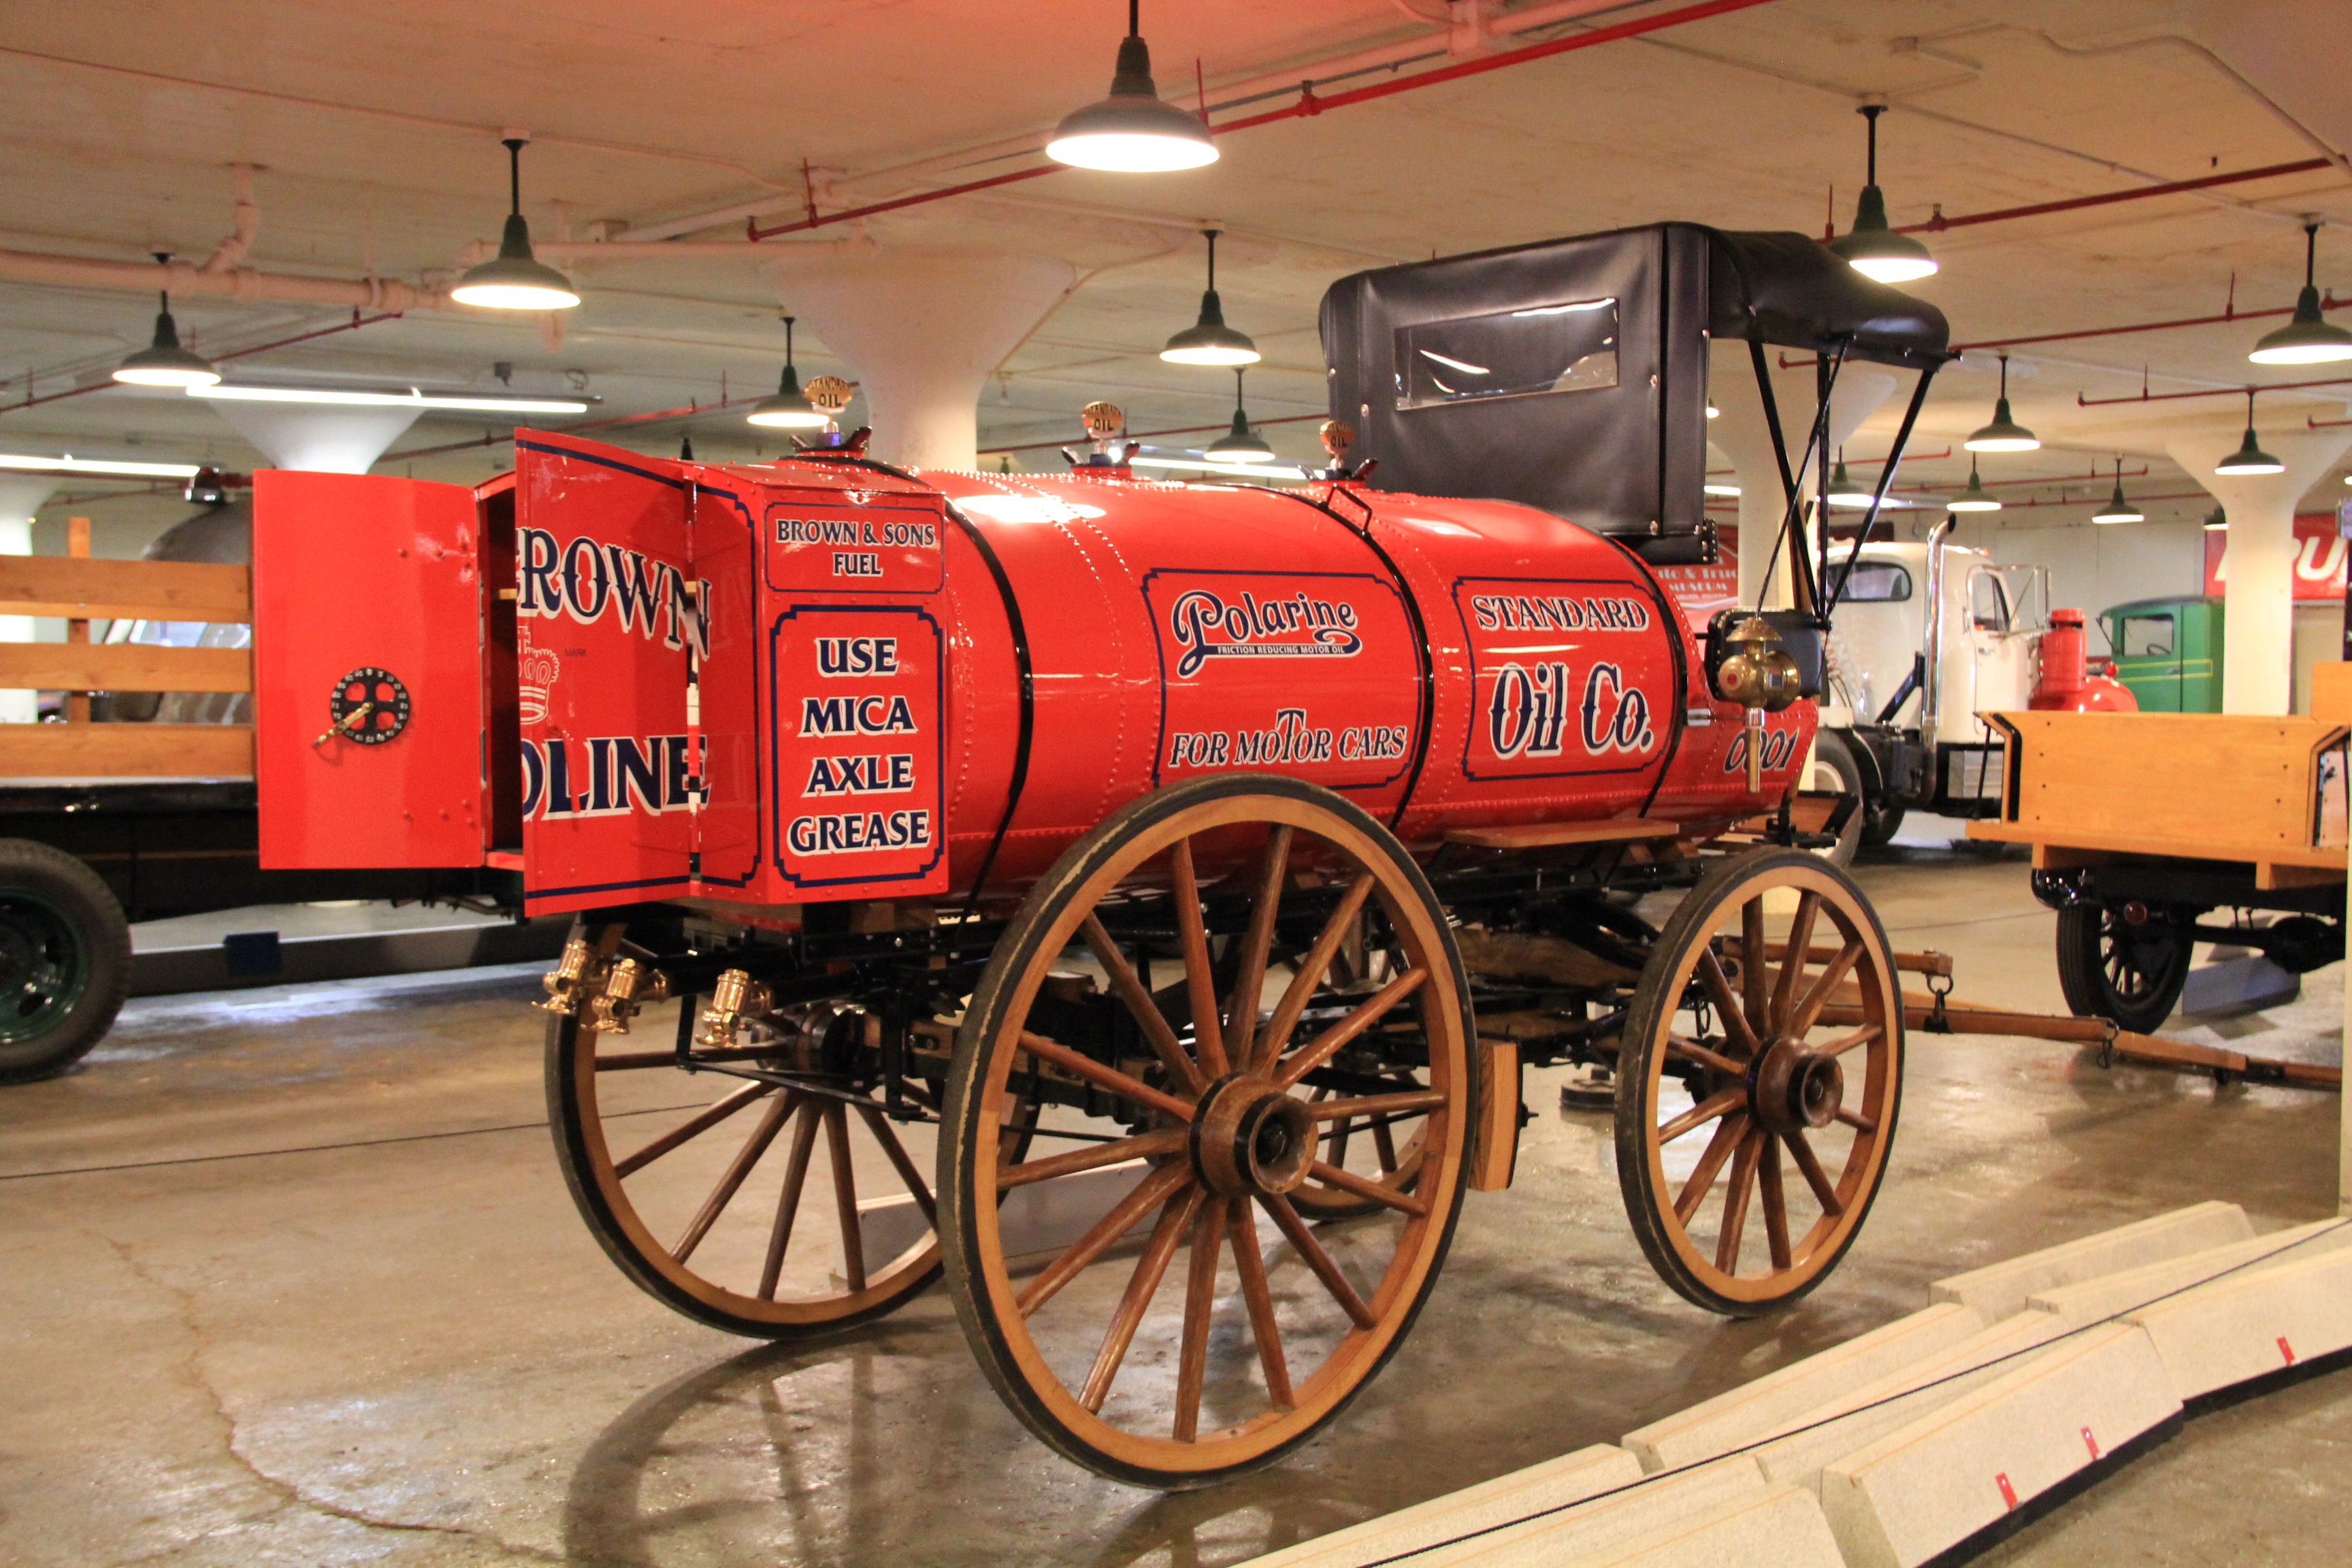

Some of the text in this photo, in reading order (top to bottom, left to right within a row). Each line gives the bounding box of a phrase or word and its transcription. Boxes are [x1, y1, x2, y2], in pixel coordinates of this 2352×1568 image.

[819, 393, 841, 407] OIL
[1094, 419, 1113, 431] OIL
[1330, 436, 1348, 447] OIL
[775, 519, 936, 549] BROWN & SONS
[832, 552, 883, 577] FUEL
[516, 527, 713, 662] ROWN
[1471, 595, 1650, 632] STANDARD
[1171, 589, 1362, 679] Polarine
[1217, 646, 1345, 654] FRICTION REDUCING MOTOR OIL
[814, 637, 900, 677] USE
[797, 696, 918, 738] MICA
[1488, 661, 1654, 760] Oil Co.
[1168, 708, 1407, 768] FOR MOTOR CARS
[800, 753, 916, 798] AXLE
[787, 809, 932, 857] GREASE
